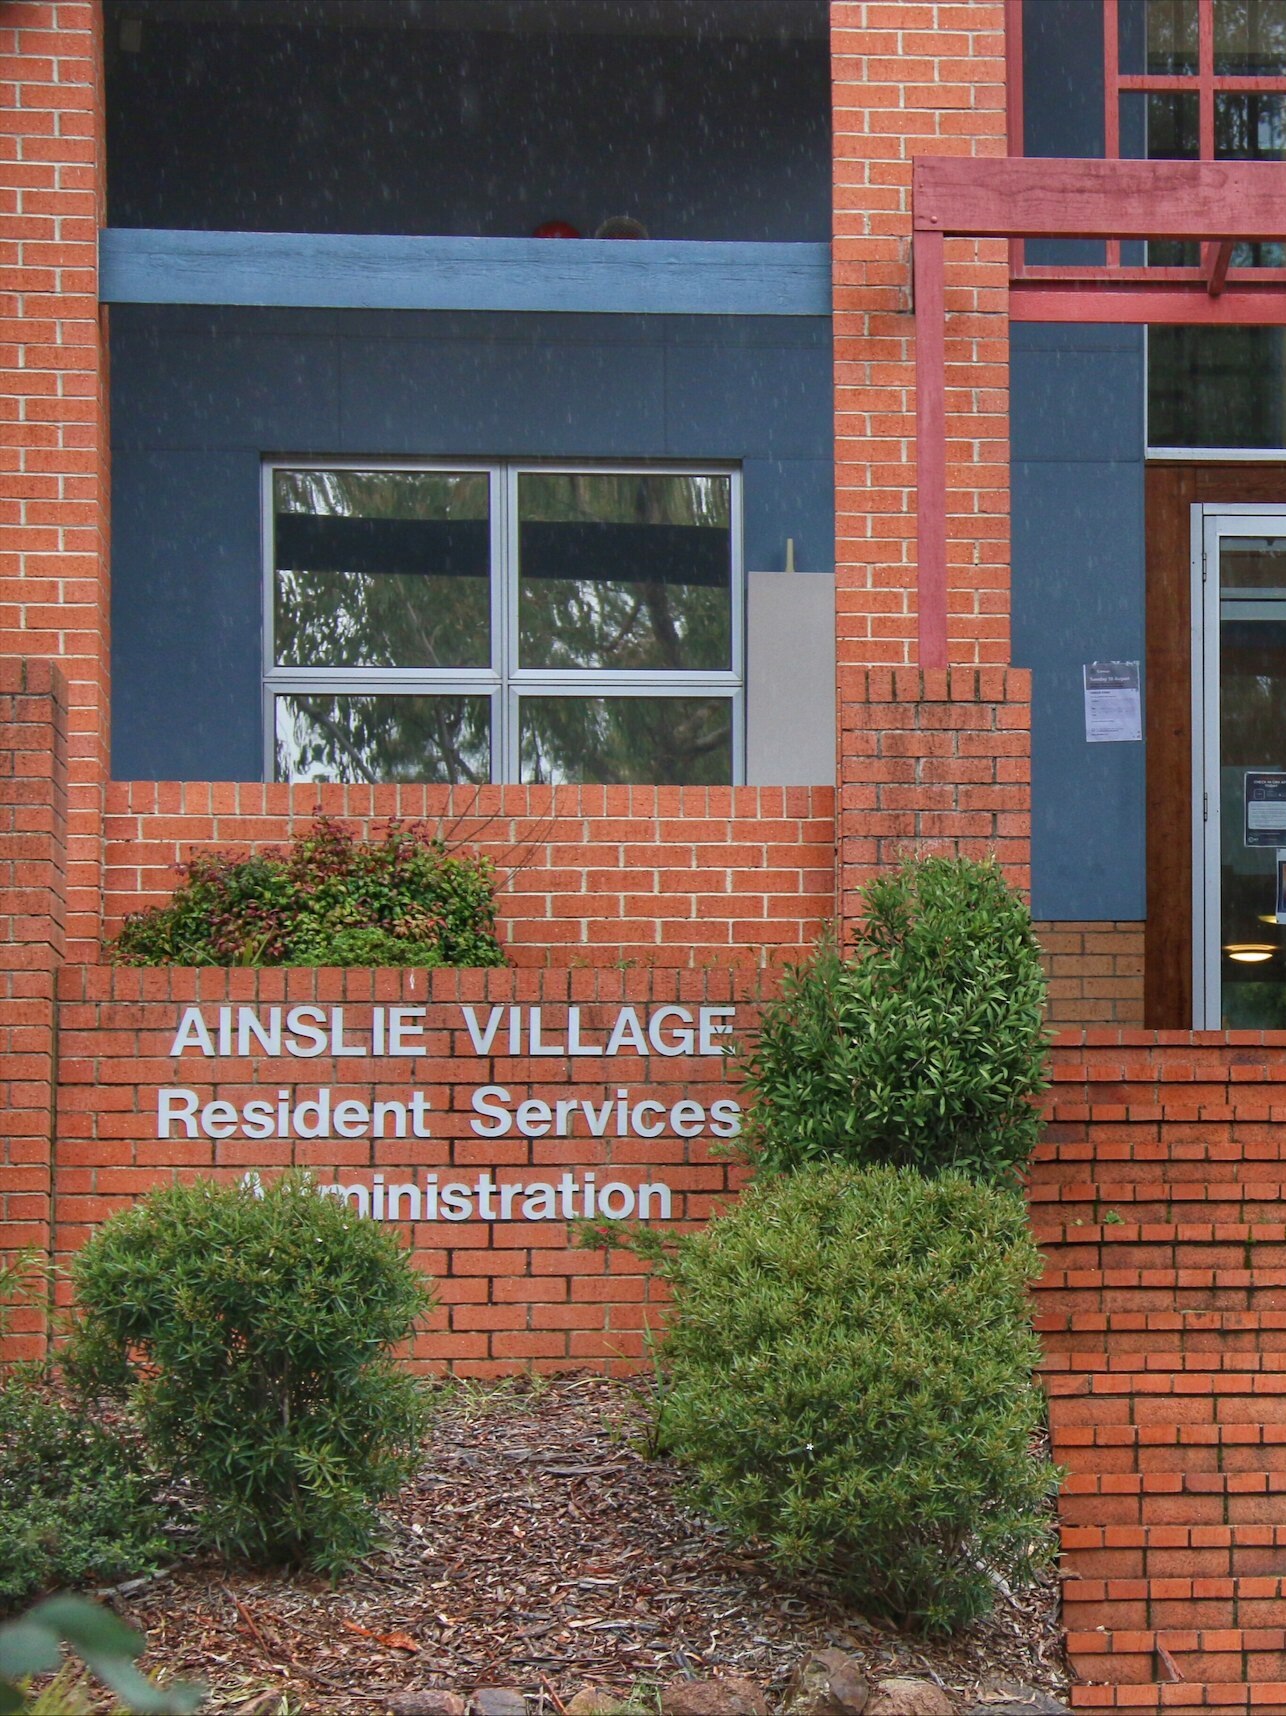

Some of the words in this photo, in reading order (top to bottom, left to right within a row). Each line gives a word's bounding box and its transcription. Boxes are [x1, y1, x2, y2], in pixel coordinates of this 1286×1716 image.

[170, 1006, 427, 1057] AINSLIE
[461, 1005, 737, 1056] VILLAGE
[158, 1088, 431, 1139] Resident
[470, 1085, 743, 1138] Services
